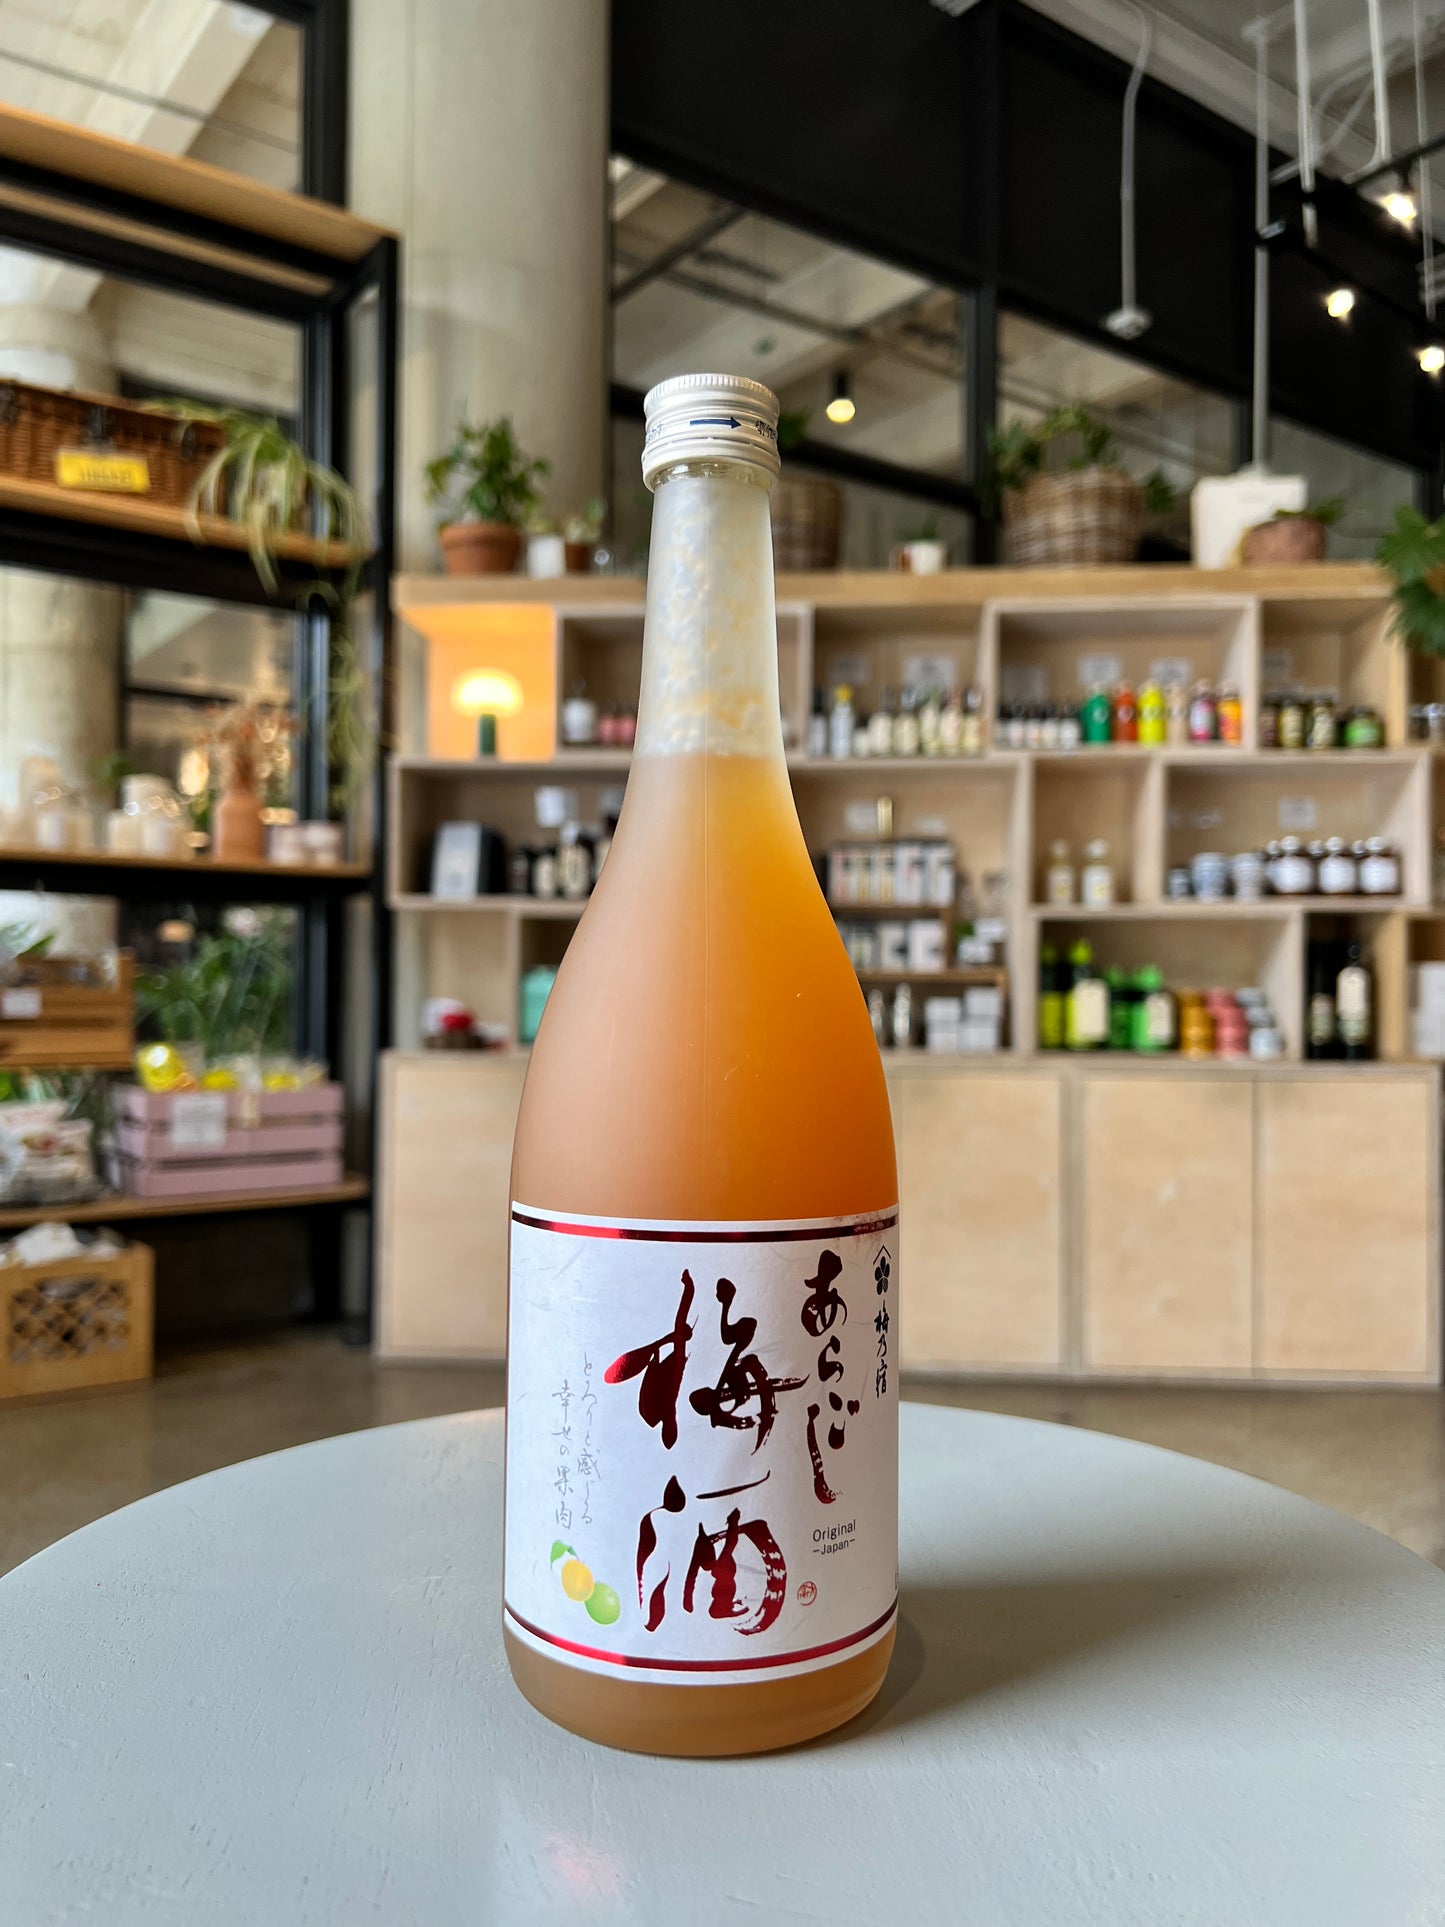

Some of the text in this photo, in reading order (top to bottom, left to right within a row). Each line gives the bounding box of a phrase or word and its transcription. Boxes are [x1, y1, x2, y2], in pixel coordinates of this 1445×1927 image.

[801, 1249, 860, 1505] あらごし
[873, 1299, 890, 1399] 梅乃宿
[551, 1378, 575, 1530] 幸せの果肉
[603, 1268, 810, 1636] 梅酒
[812, 1518, 856, 1542] Original
